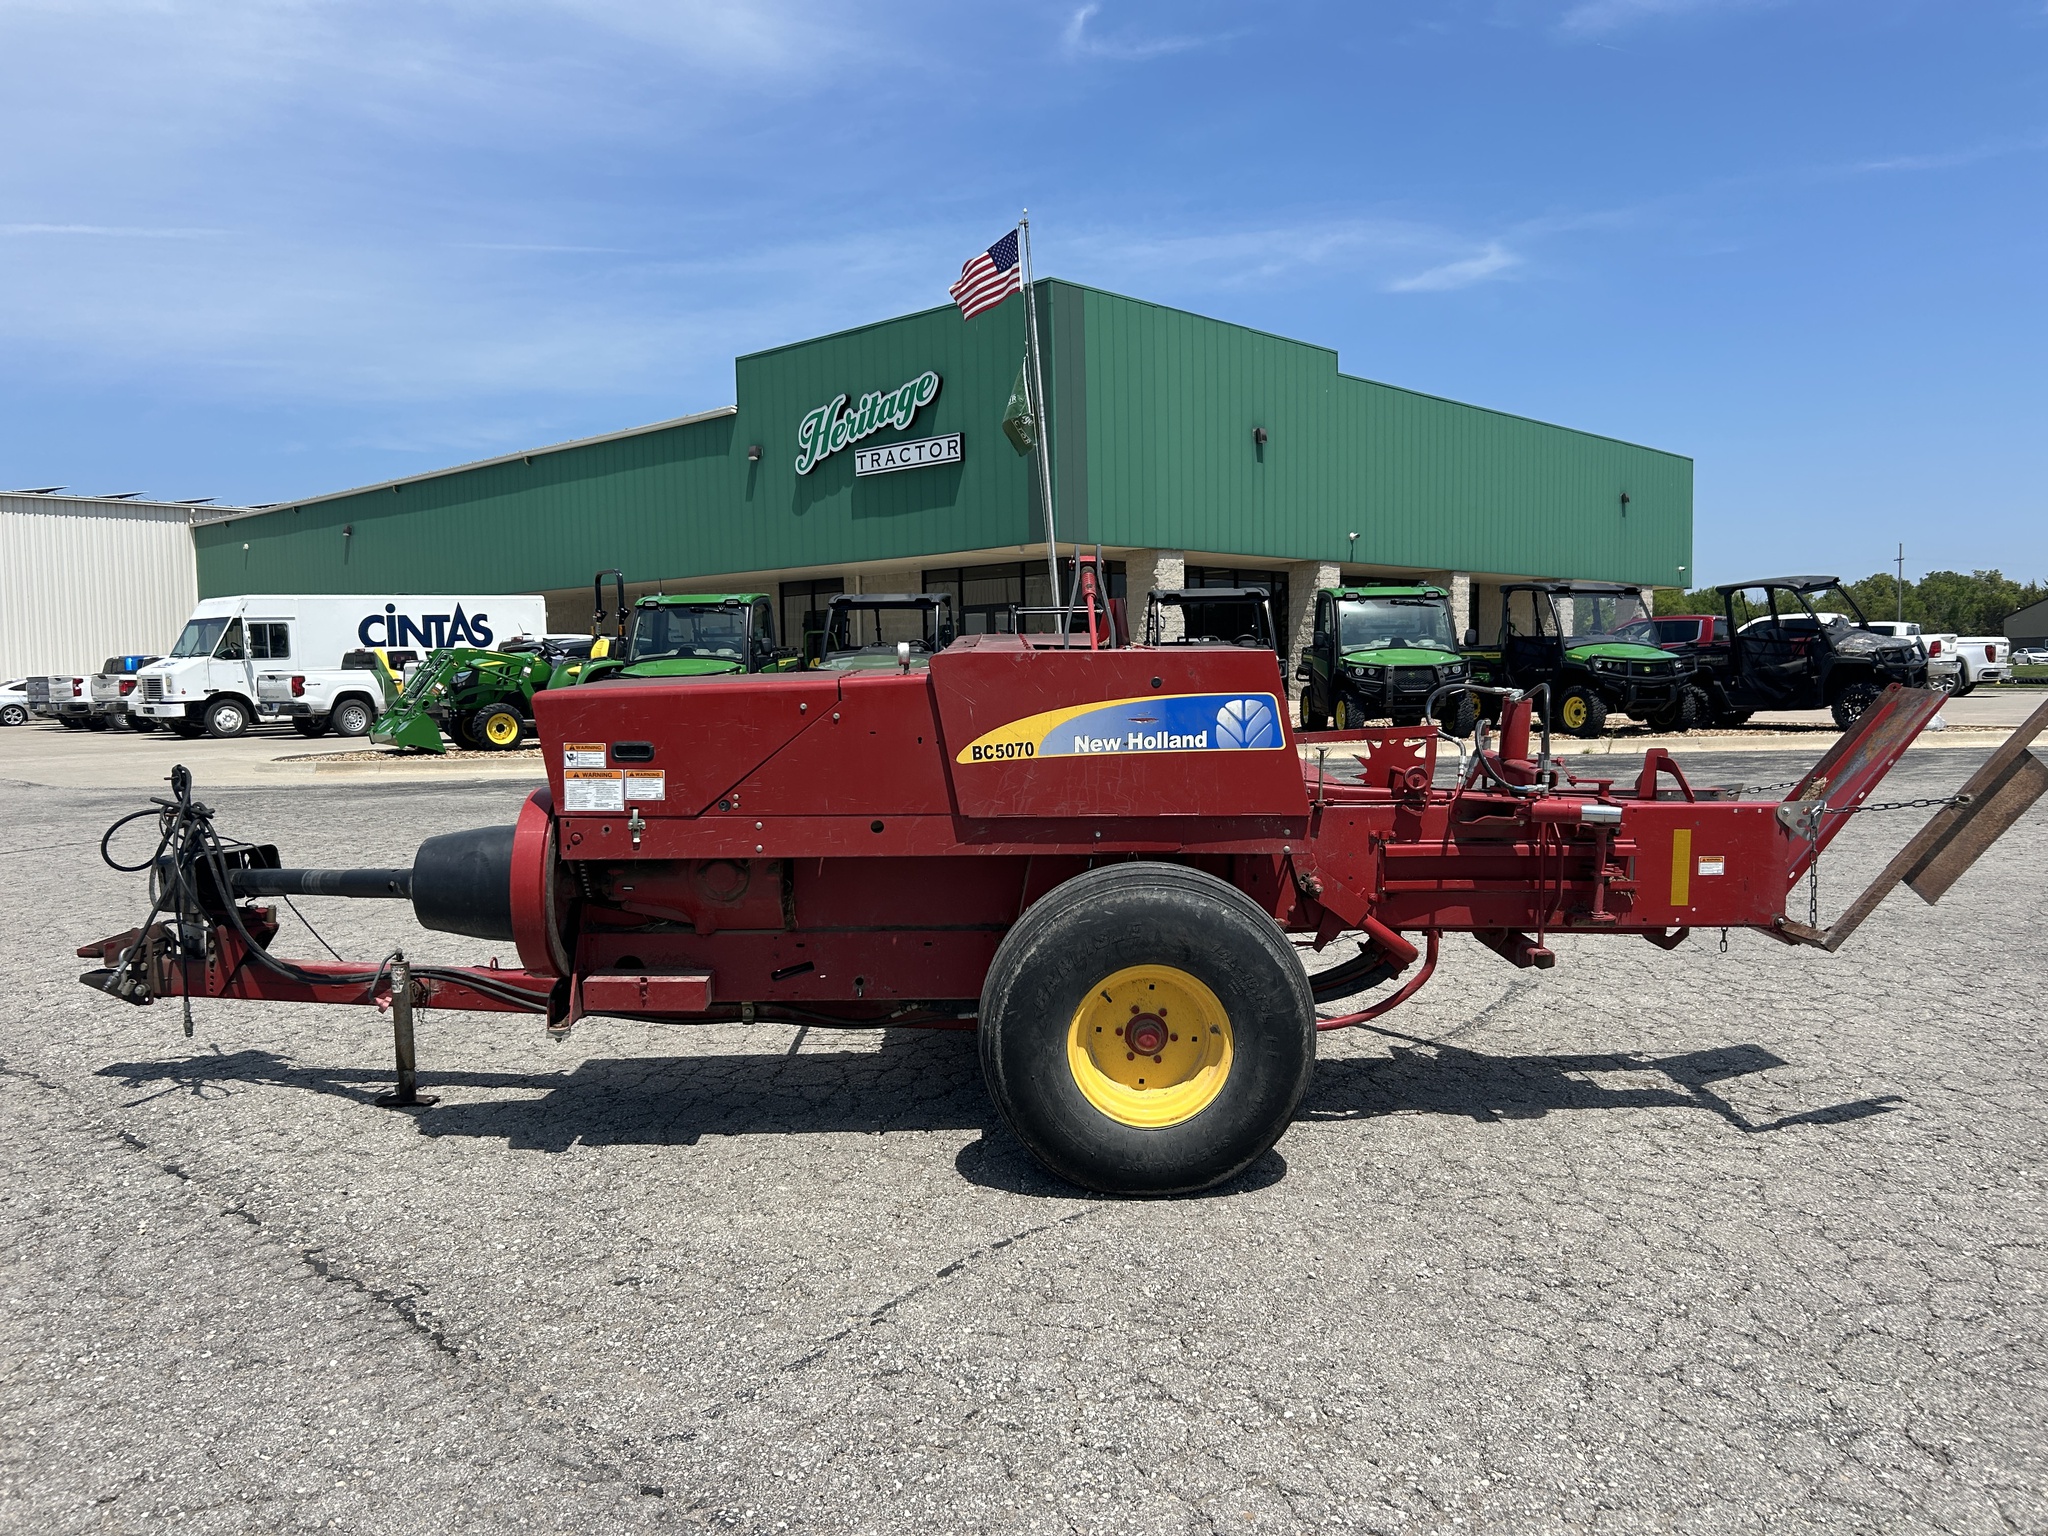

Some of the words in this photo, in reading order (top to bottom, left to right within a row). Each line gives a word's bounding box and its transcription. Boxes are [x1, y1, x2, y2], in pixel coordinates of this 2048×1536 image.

[796, 371, 939, 475] Heritage
[857, 440, 958, 470] TRACTOR
[972, 741, 1034, 760] BC5070
[1074, 734, 1122, 753] New
[1128, 731, 1207, 750] Holland
